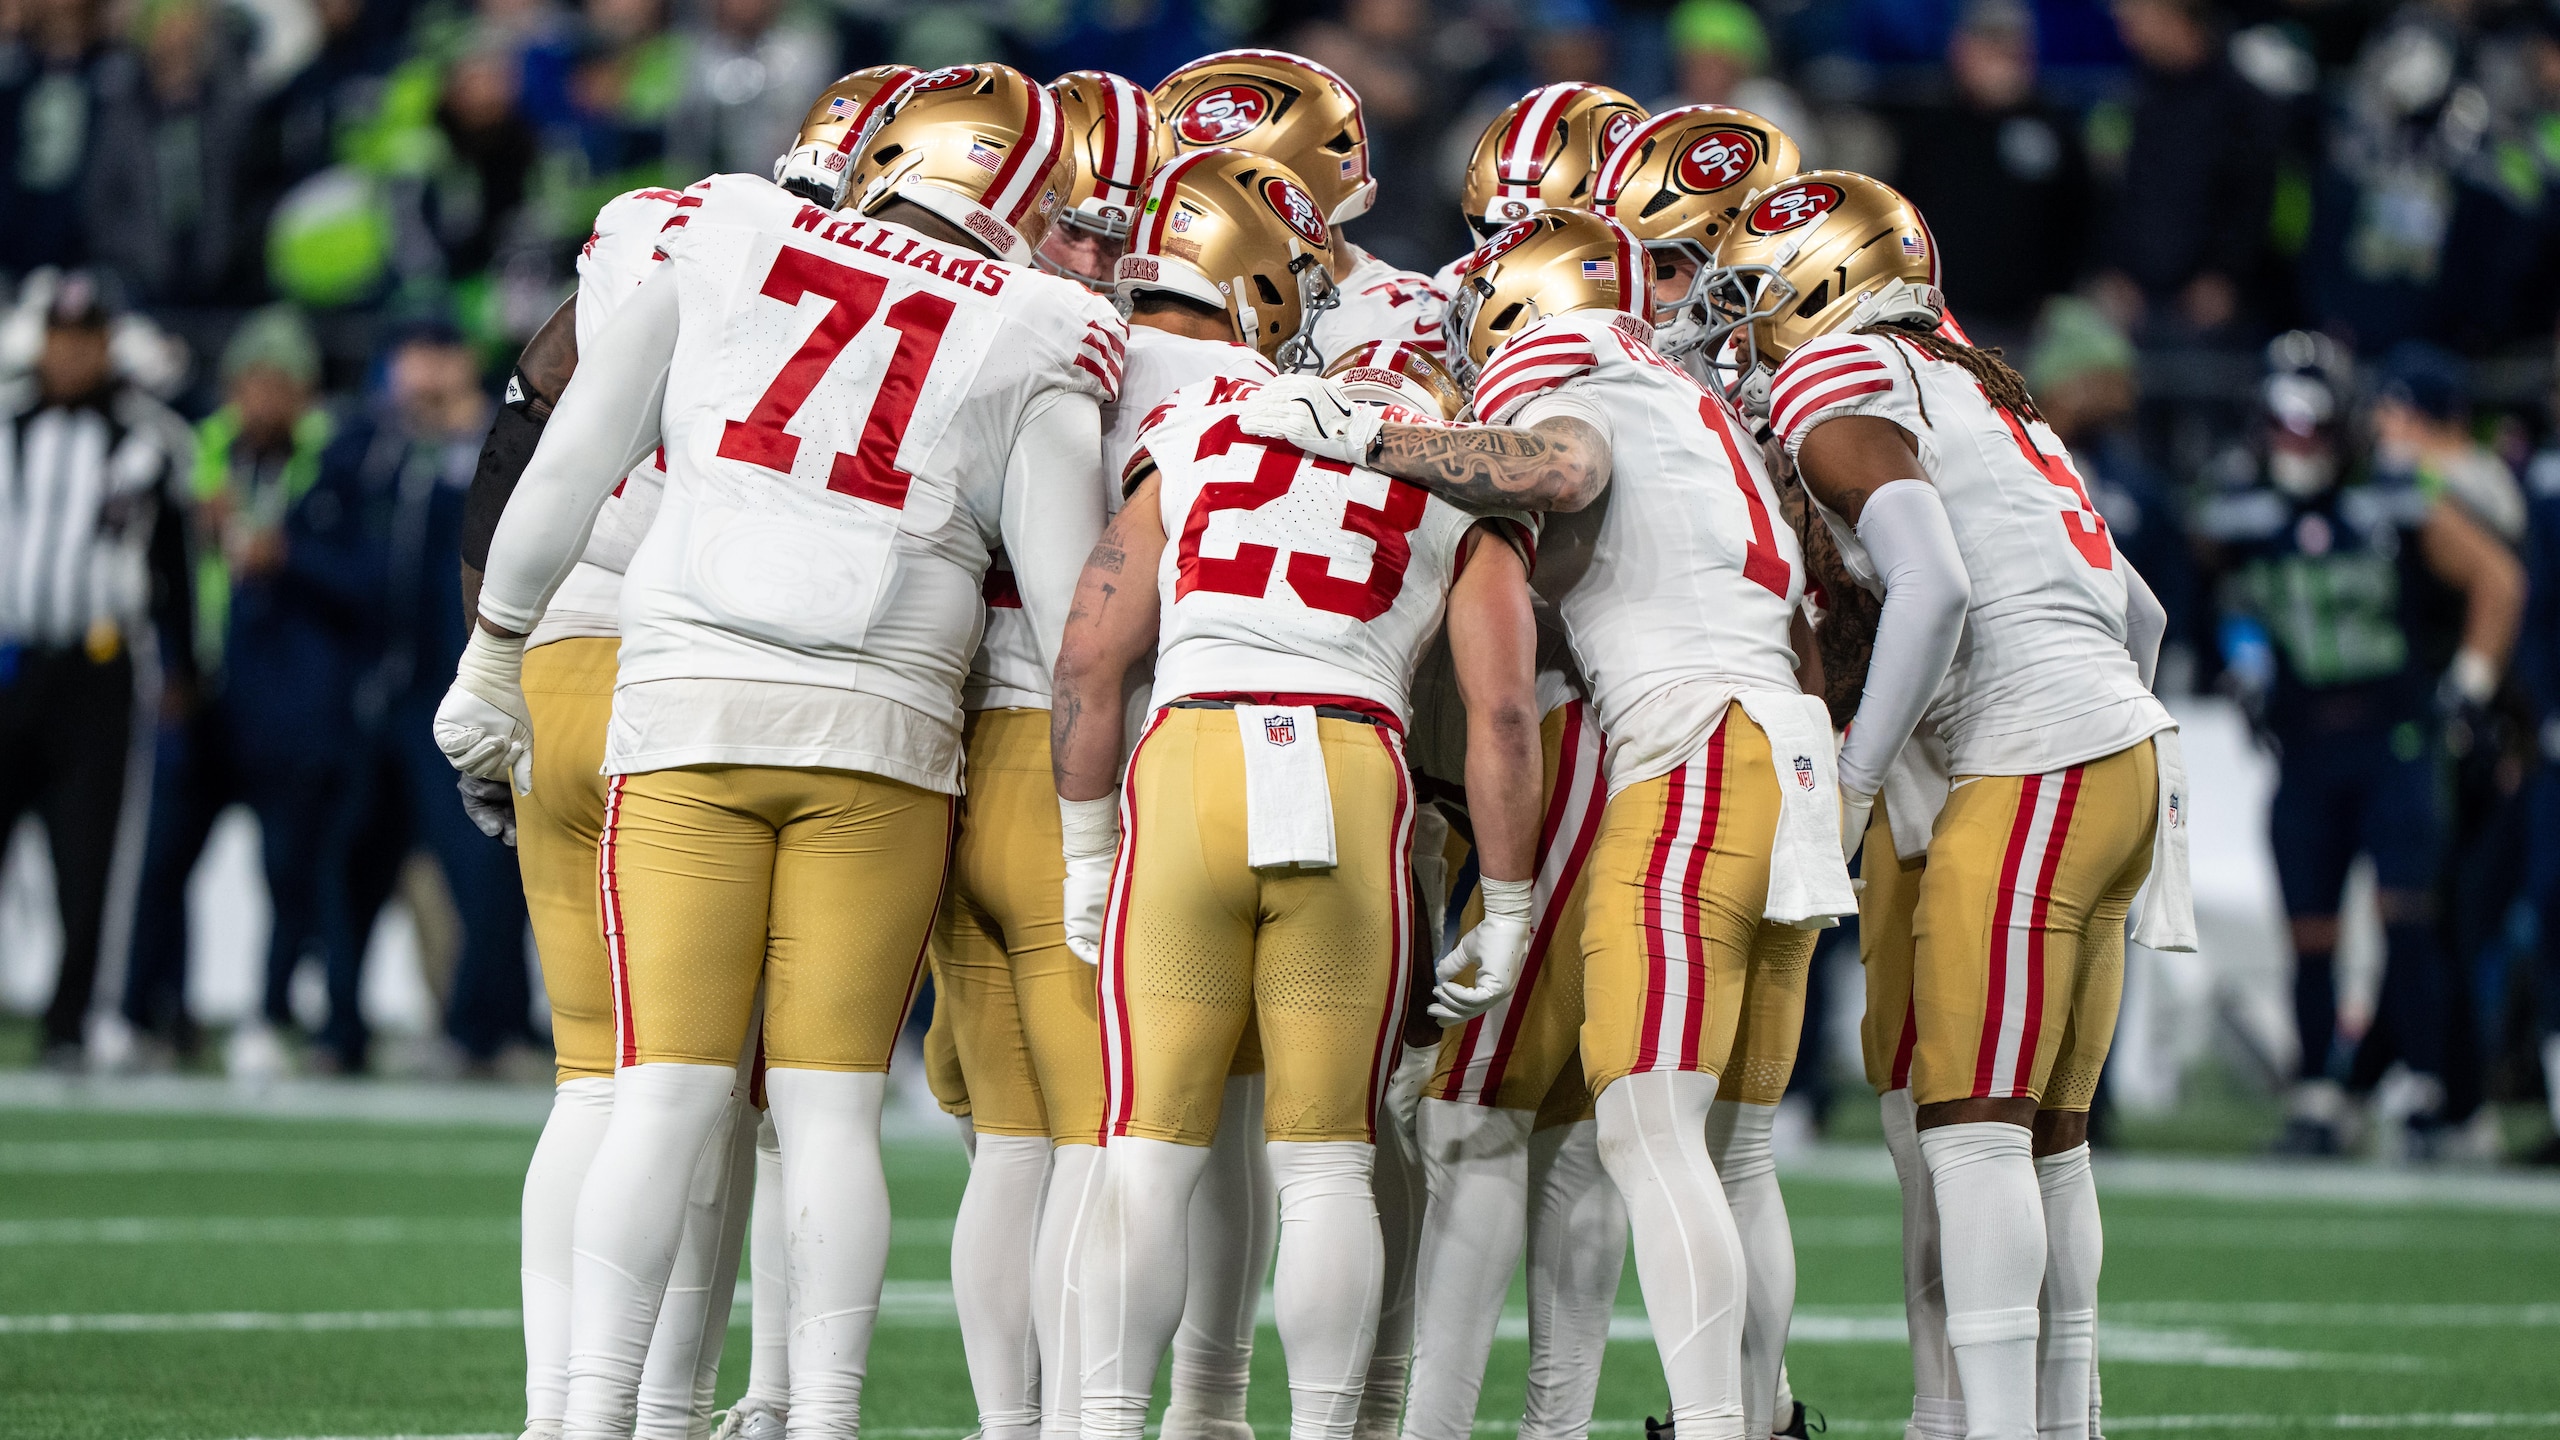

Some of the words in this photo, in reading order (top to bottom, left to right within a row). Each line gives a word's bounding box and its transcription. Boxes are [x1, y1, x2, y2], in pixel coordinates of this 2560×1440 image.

[1196, 90, 1257, 138] SF
[1690, 137, 1747, 183] SF
[1284, 186, 1323, 235] SF
[1506, 203, 1524, 218] SF
[1769, 187, 1826, 227] SF
[791, 203, 1012, 297] WILLIAMS
[964, 209, 1018, 254] 49ERS
[716, 245, 956, 510] 71
[1342, 368, 1404, 389] 49ERS
[1174, 413, 1431, 623] 23
[1698, 394, 1791, 601] 1
